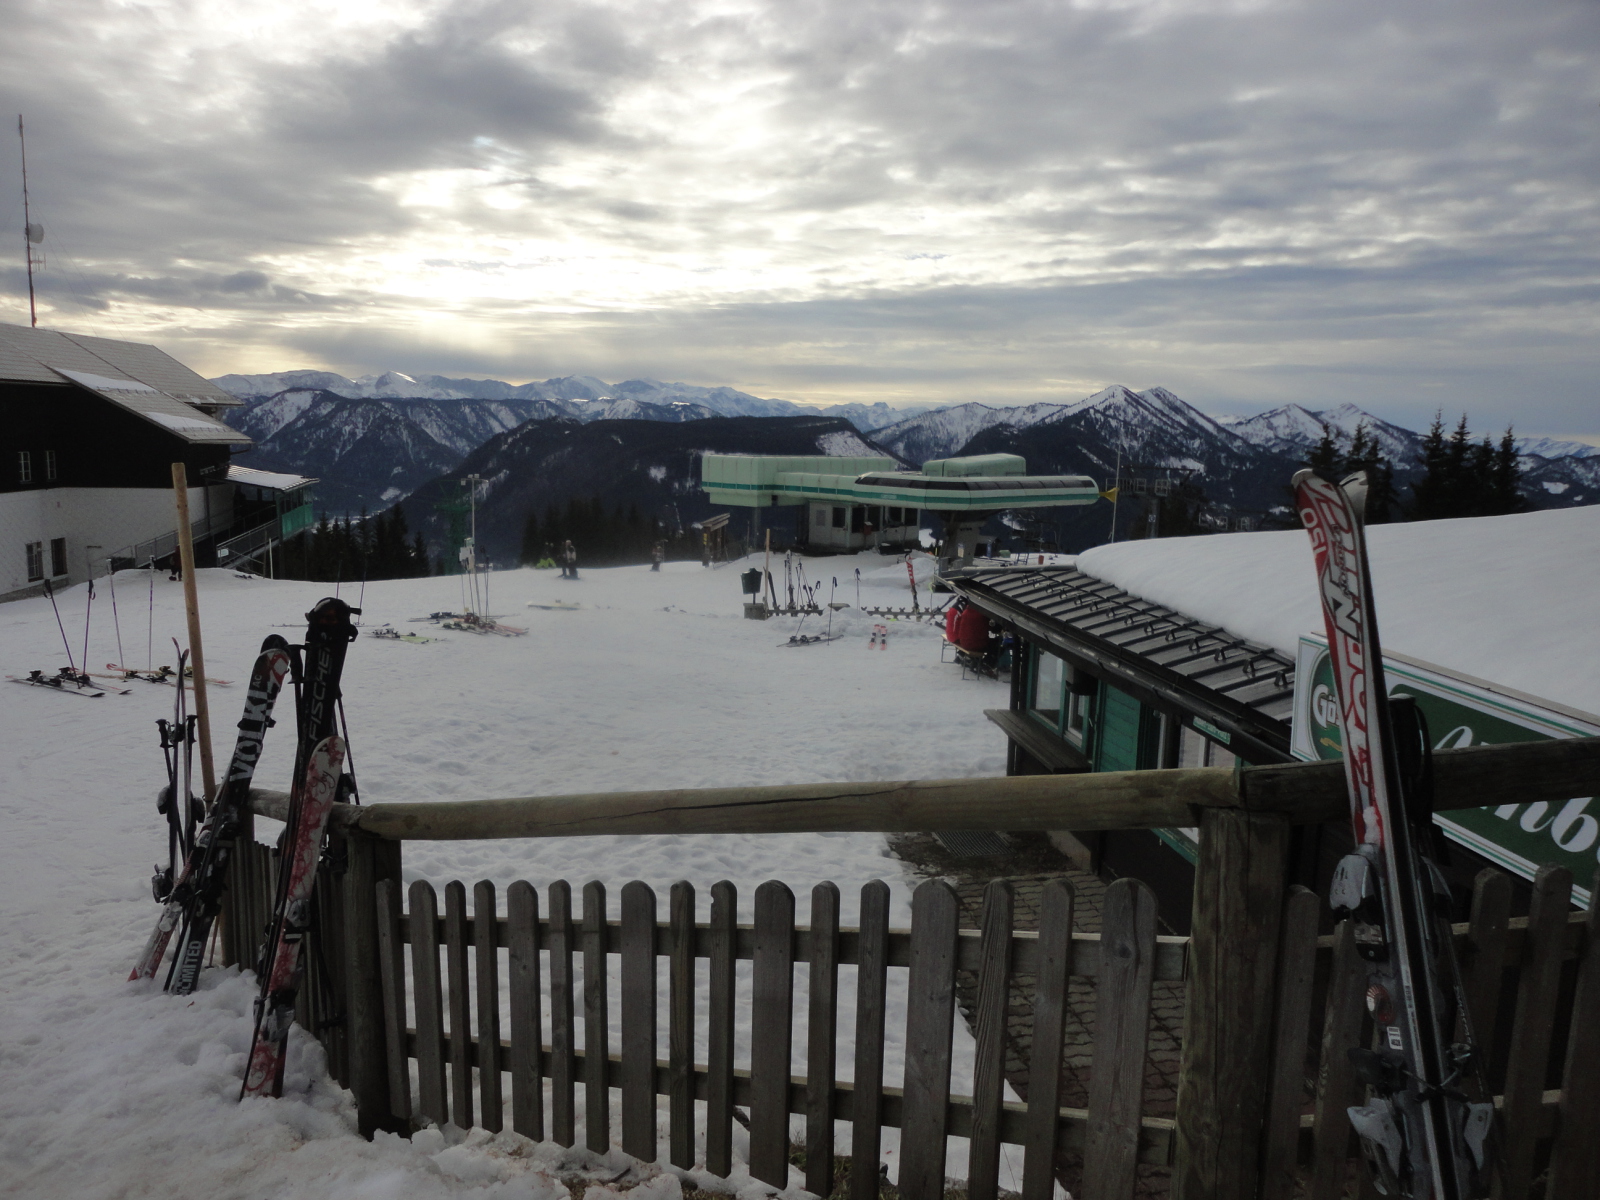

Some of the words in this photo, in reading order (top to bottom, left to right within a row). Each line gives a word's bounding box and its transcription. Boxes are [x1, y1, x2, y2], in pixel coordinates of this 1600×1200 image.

[1299, 507, 1327, 555] 150
[251, 673, 262, 689] AC
[307, 769, 335, 793] Joy
